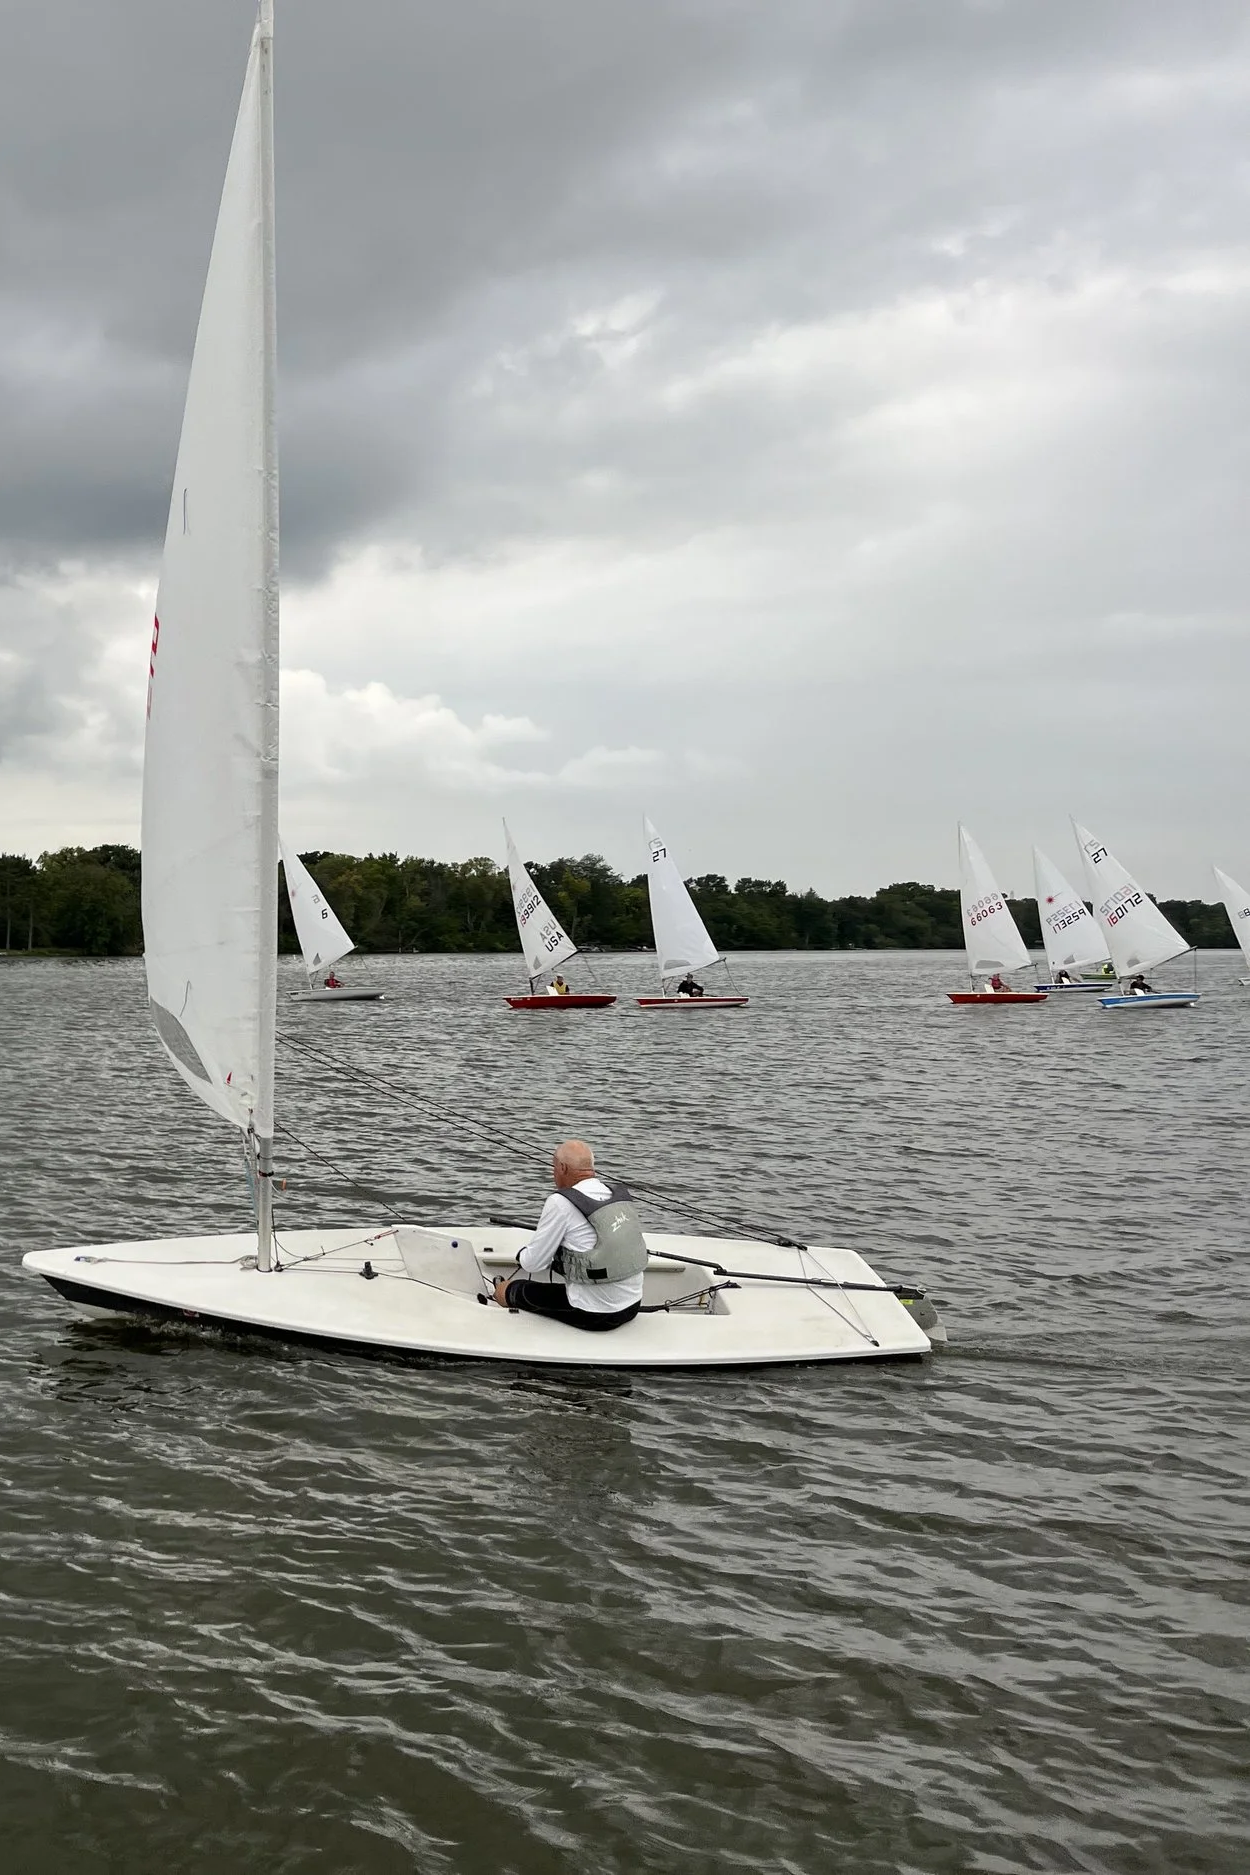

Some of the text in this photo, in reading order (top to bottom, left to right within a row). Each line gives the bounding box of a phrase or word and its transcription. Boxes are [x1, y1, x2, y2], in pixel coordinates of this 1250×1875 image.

[652, 848, 667, 862] 27
[1091, 847, 1108, 864] 27
[321, 908, 328, 919] 6
[520, 895, 541, 928] 199912
[971, 902, 1002, 926] 66063
[1052, 908, 1086, 934] 173259
[1107, 893, 1143, 927] 160172
[545, 931, 564, 952] USA
